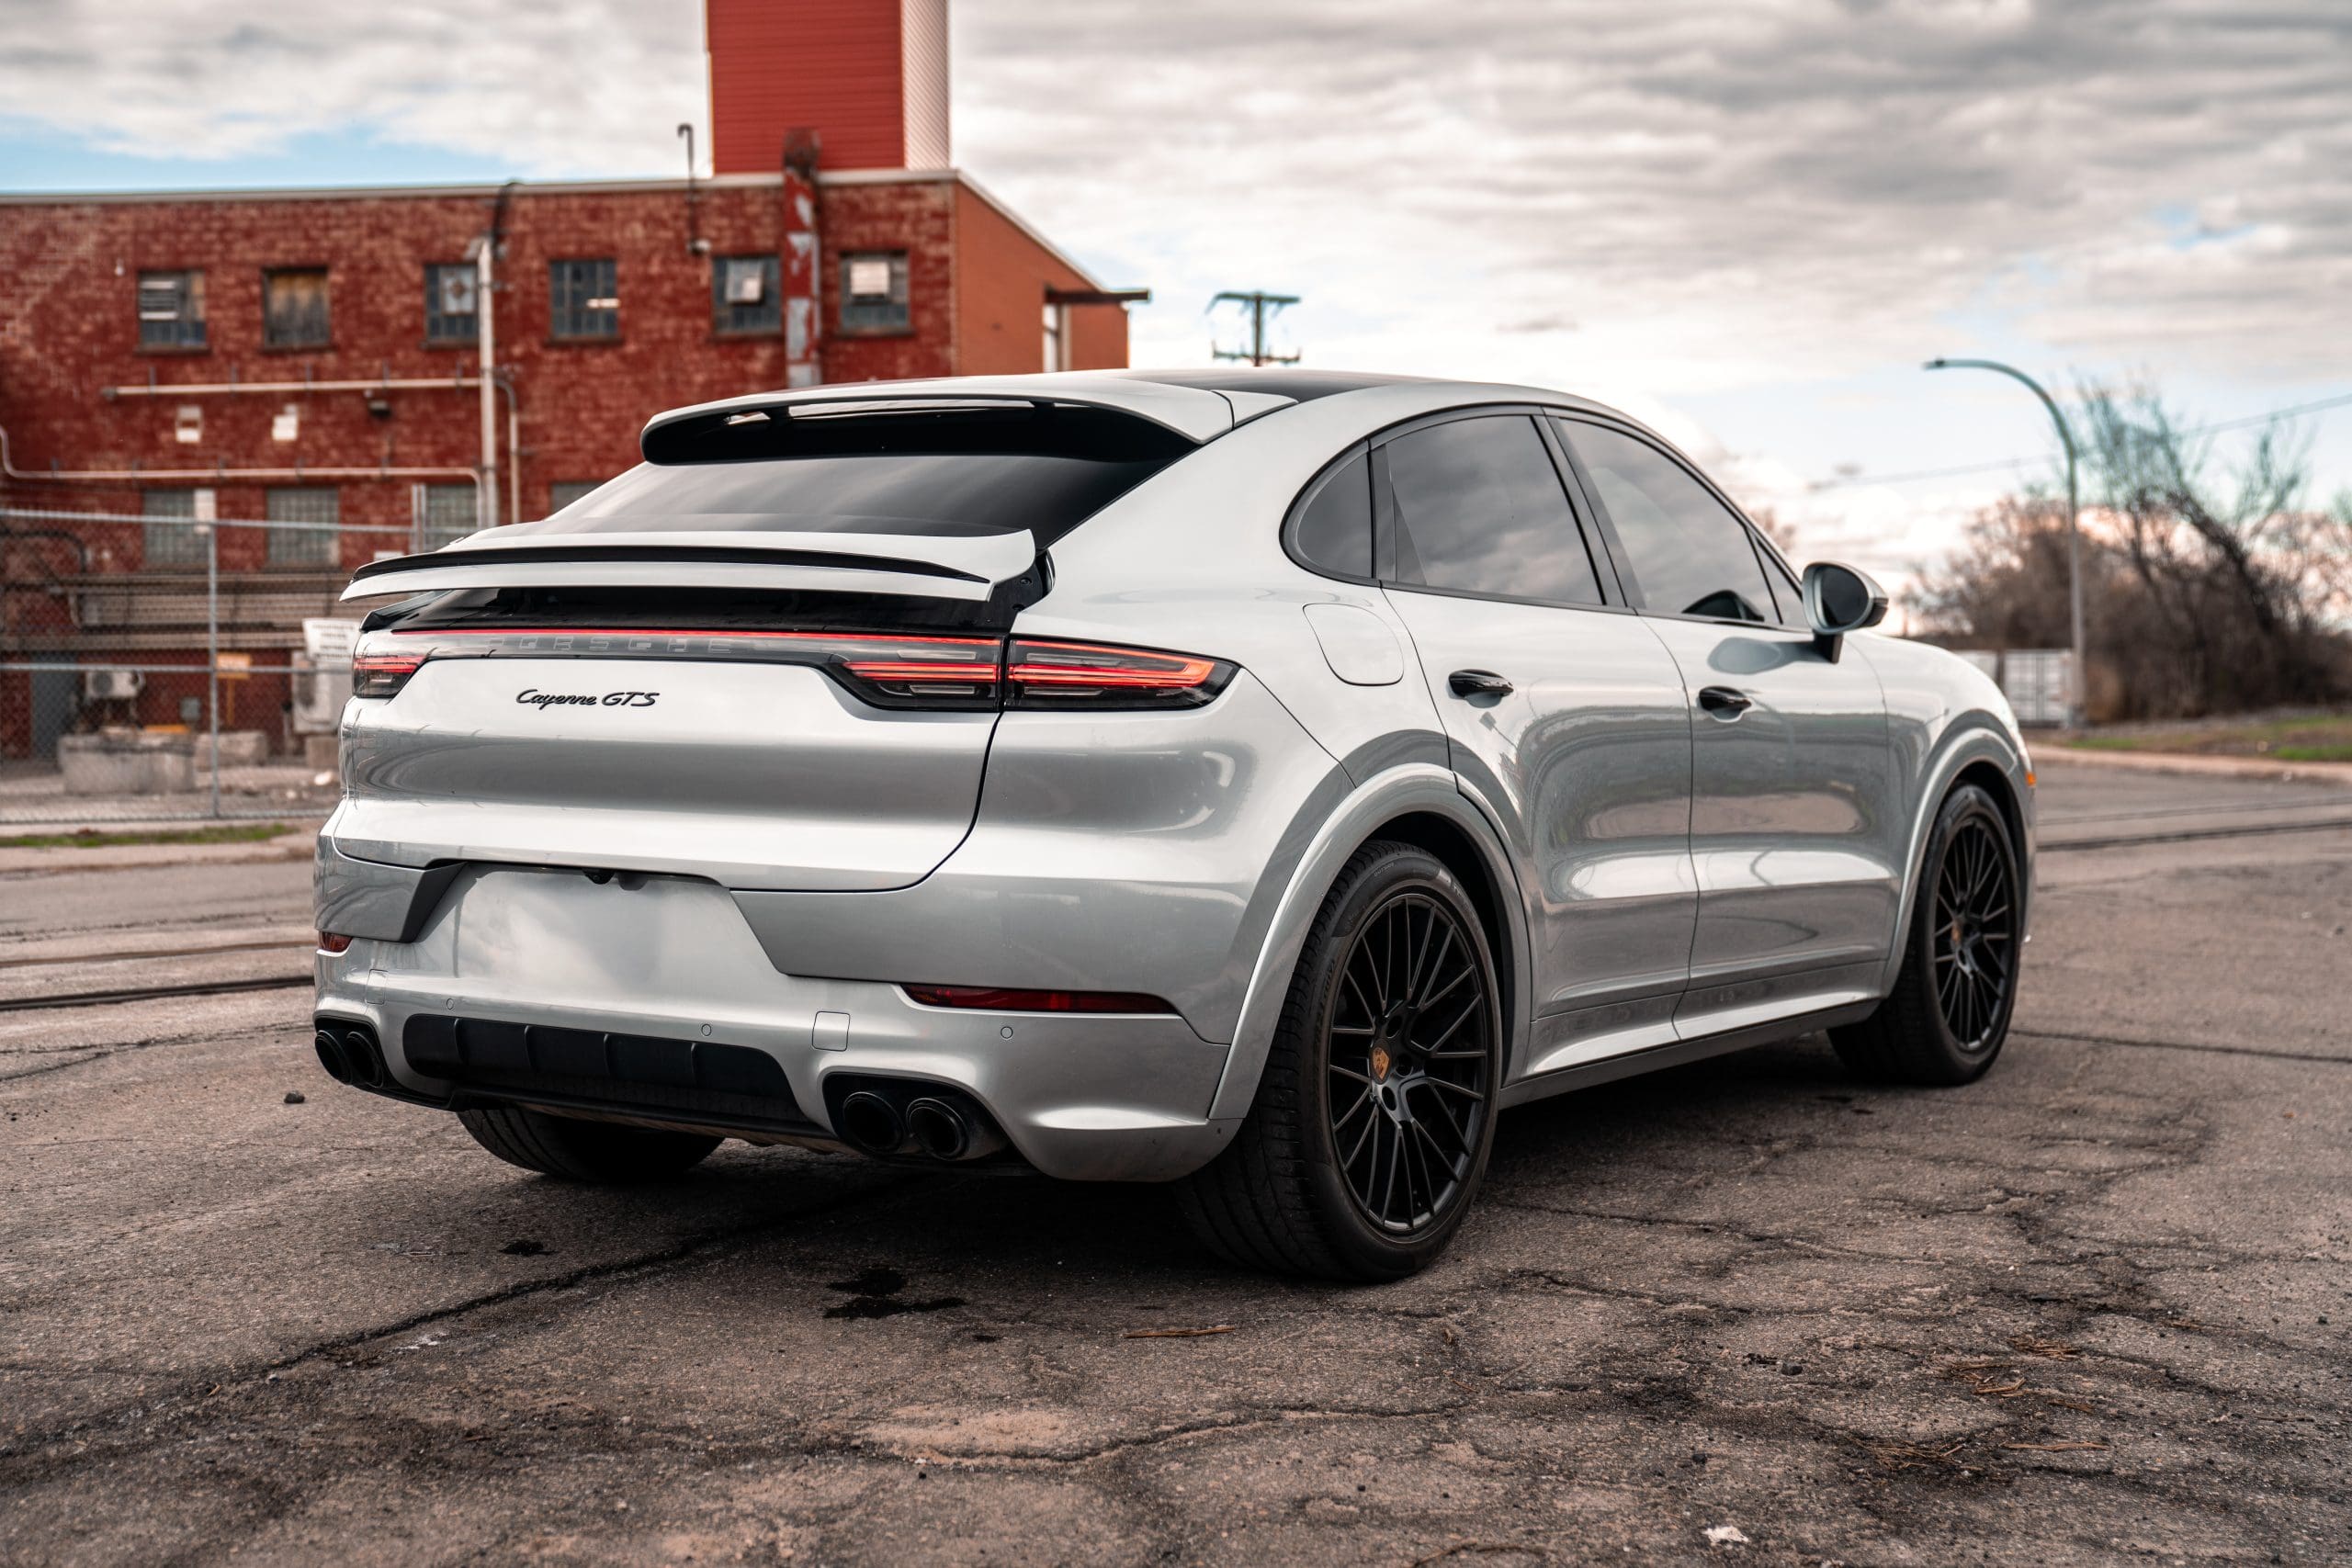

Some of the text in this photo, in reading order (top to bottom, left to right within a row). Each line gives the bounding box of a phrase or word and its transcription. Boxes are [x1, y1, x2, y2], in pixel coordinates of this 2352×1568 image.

[485, 635, 734, 653] PORSCHE
[515, 689, 660, 710] Cayenne GTS
